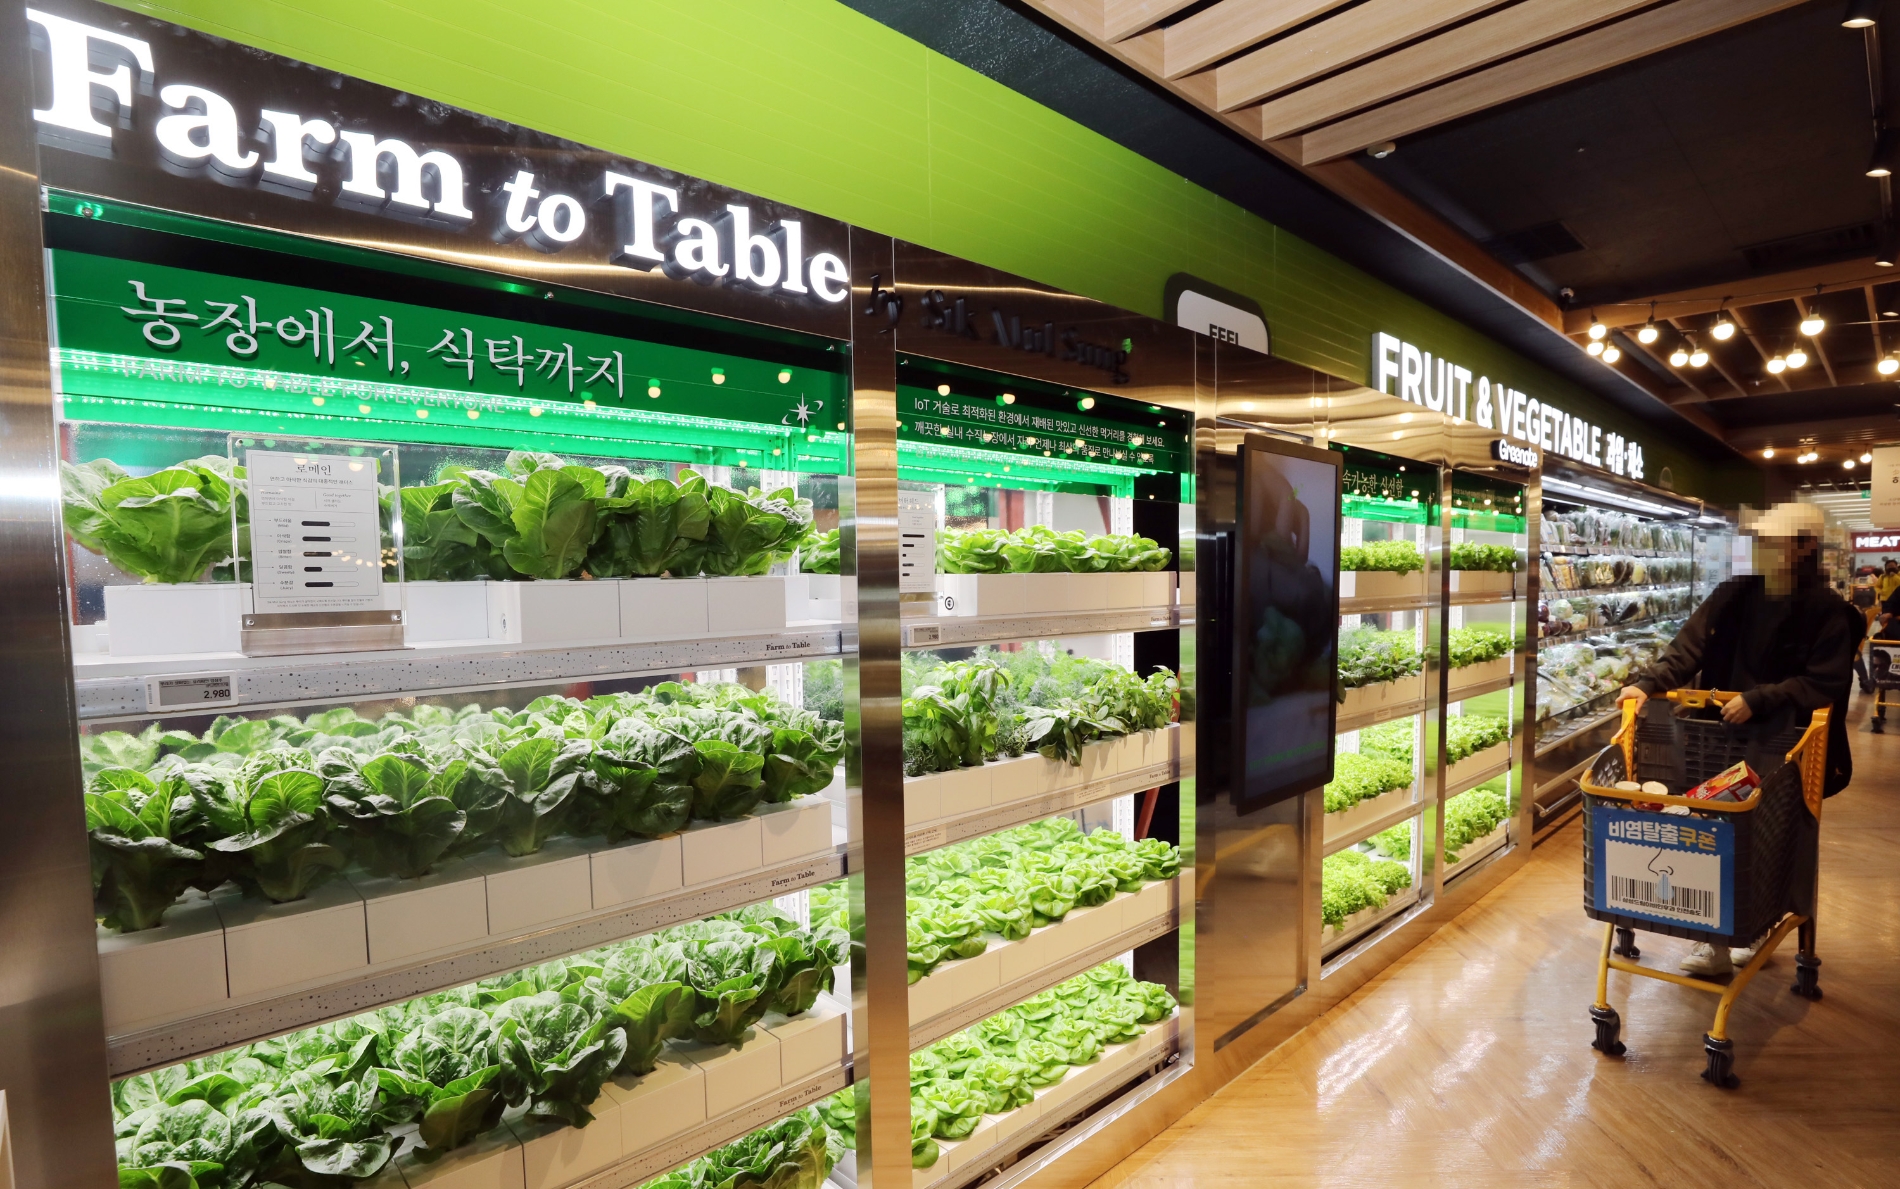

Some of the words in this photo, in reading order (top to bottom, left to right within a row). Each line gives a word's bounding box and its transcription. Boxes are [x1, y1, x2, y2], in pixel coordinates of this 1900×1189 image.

[26, 7, 473, 220] Farm
[502, 170, 587, 242] to
[606, 171, 849, 302] Table
[120, 280, 409, 375] 농장에서,
[426, 327, 624, 399] 식탁까지
[122, 358, 203, 385] FARM
[212, 366, 249, 389] TO
[261, 371, 334, 398] TABLE
[339, 379, 388, 403] FOR
[395, 385, 506, 414] EVERYONE
[1374, 331, 1472, 421] FRUIT
[1475, 376, 1494, 429] &
[1497, 383, 1602, 467] VEGETABLE
[914, 398, 930, 411] IoT
[962, 405, 996, 422] 최적화된
[998, 410, 1030, 427] 환경에서
[1031, 416, 1054, 432] 재배된
[1055, 420, 1077, 433] 맛있고
[1078, 424, 1099, 438] 신선한
[296, 464, 332, 476] 로메인
[1855, 536, 1900, 548] MEAT
[766, 643, 785, 651] Farm
[792, 641, 811, 649] Table
[203, 689, 231, 699] 2.980
[1608, 819, 1717, 852] 비염탈출쿠폰
[771, 877, 790, 887] Farm
[796, 870, 816, 880] Table
[779, 1096, 797, 1108] Farm
[803, 1085, 822, 1097] Table
